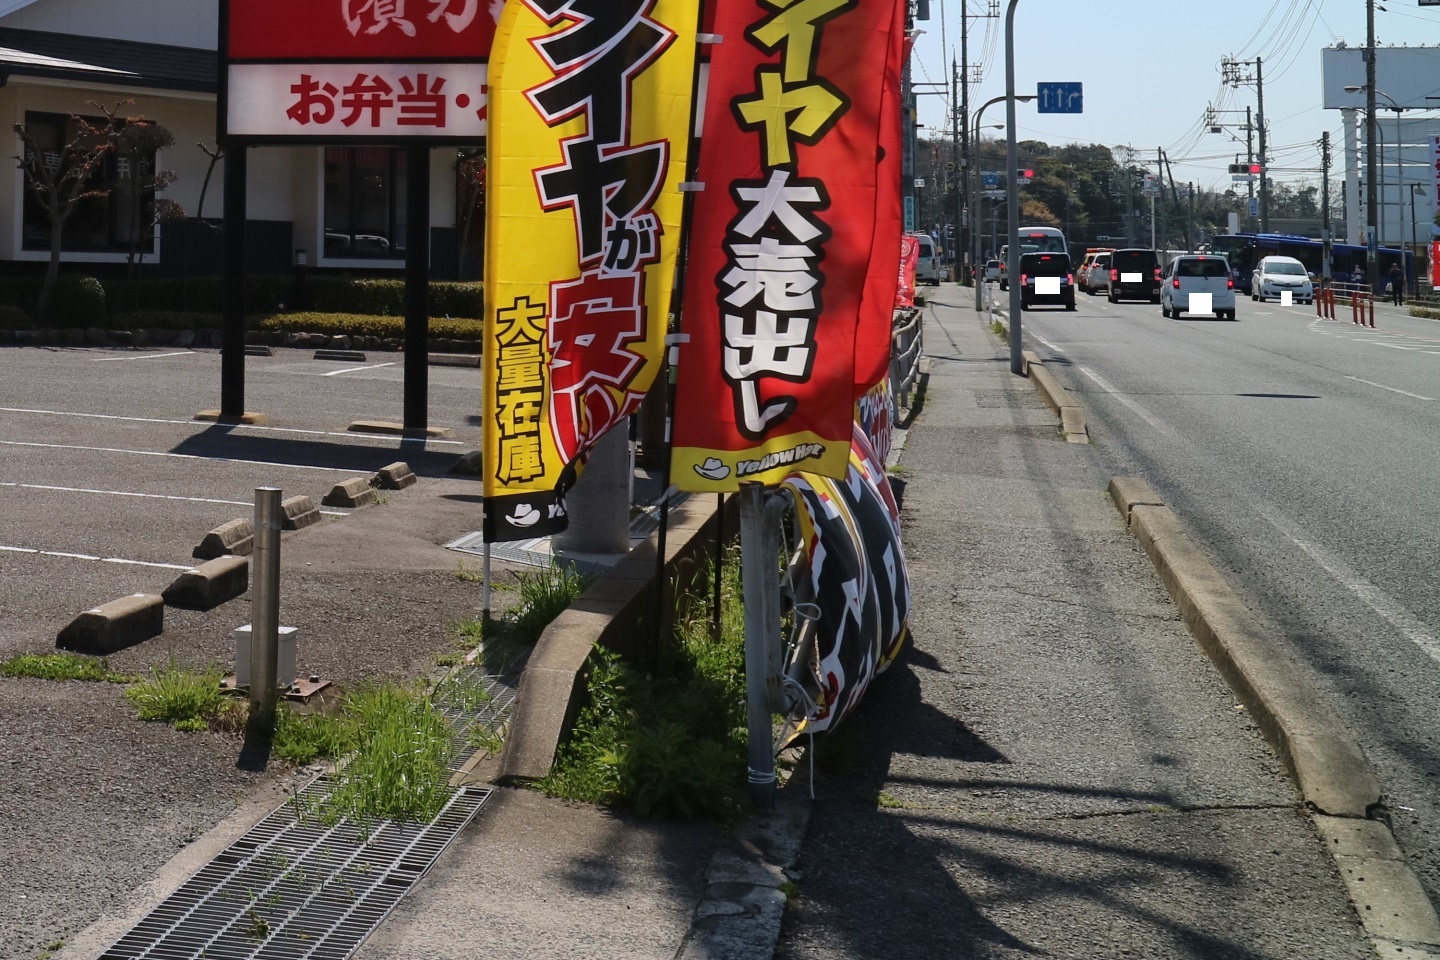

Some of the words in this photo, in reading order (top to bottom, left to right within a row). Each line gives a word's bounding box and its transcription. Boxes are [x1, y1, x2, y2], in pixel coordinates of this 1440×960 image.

[286, 72, 489, 128] お弁当・
[495, 295, 547, 487] 大量在庫
